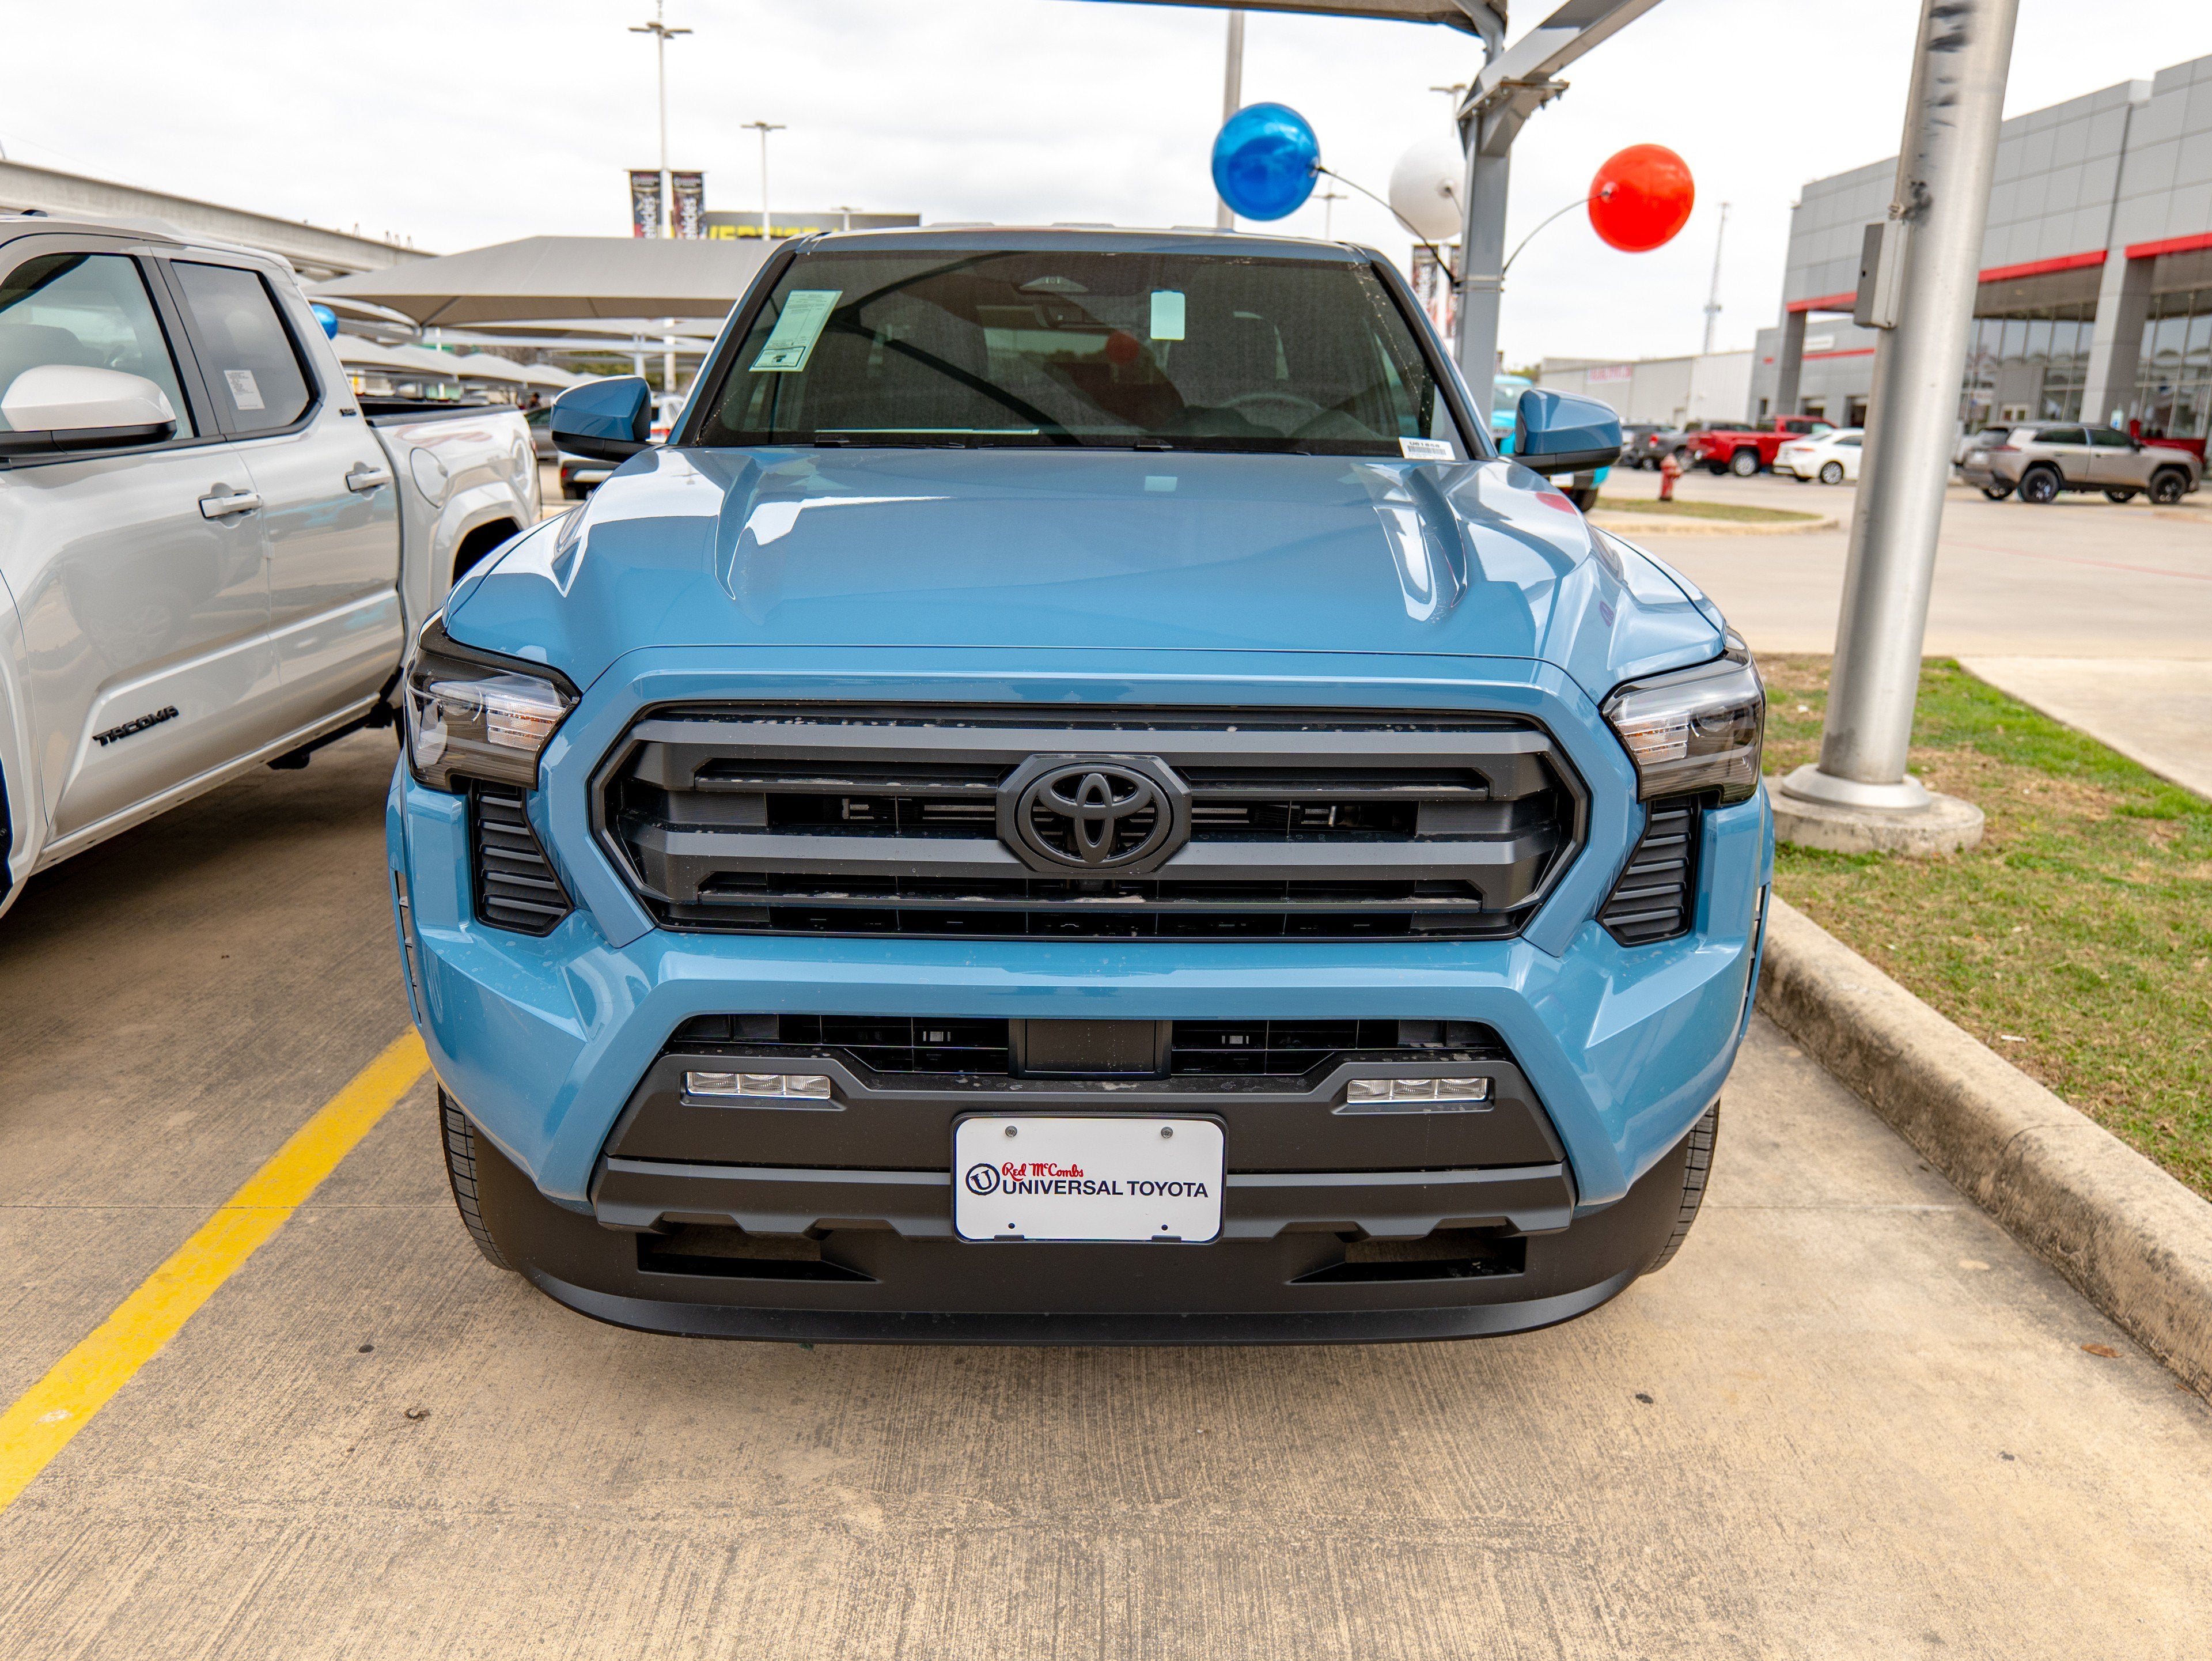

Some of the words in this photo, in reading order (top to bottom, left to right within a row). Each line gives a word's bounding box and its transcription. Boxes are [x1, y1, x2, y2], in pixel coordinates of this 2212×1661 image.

[639, 196, 657, 239] ehicles
[680, 197, 698, 240] ehicles
[92, 705, 179, 747] TACOMA
[1001, 1161, 1027, 1182] Red
[1002, 1179, 1123, 1195] UNIVERSAL
[1127, 1181, 1209, 1198] TOYOTA
